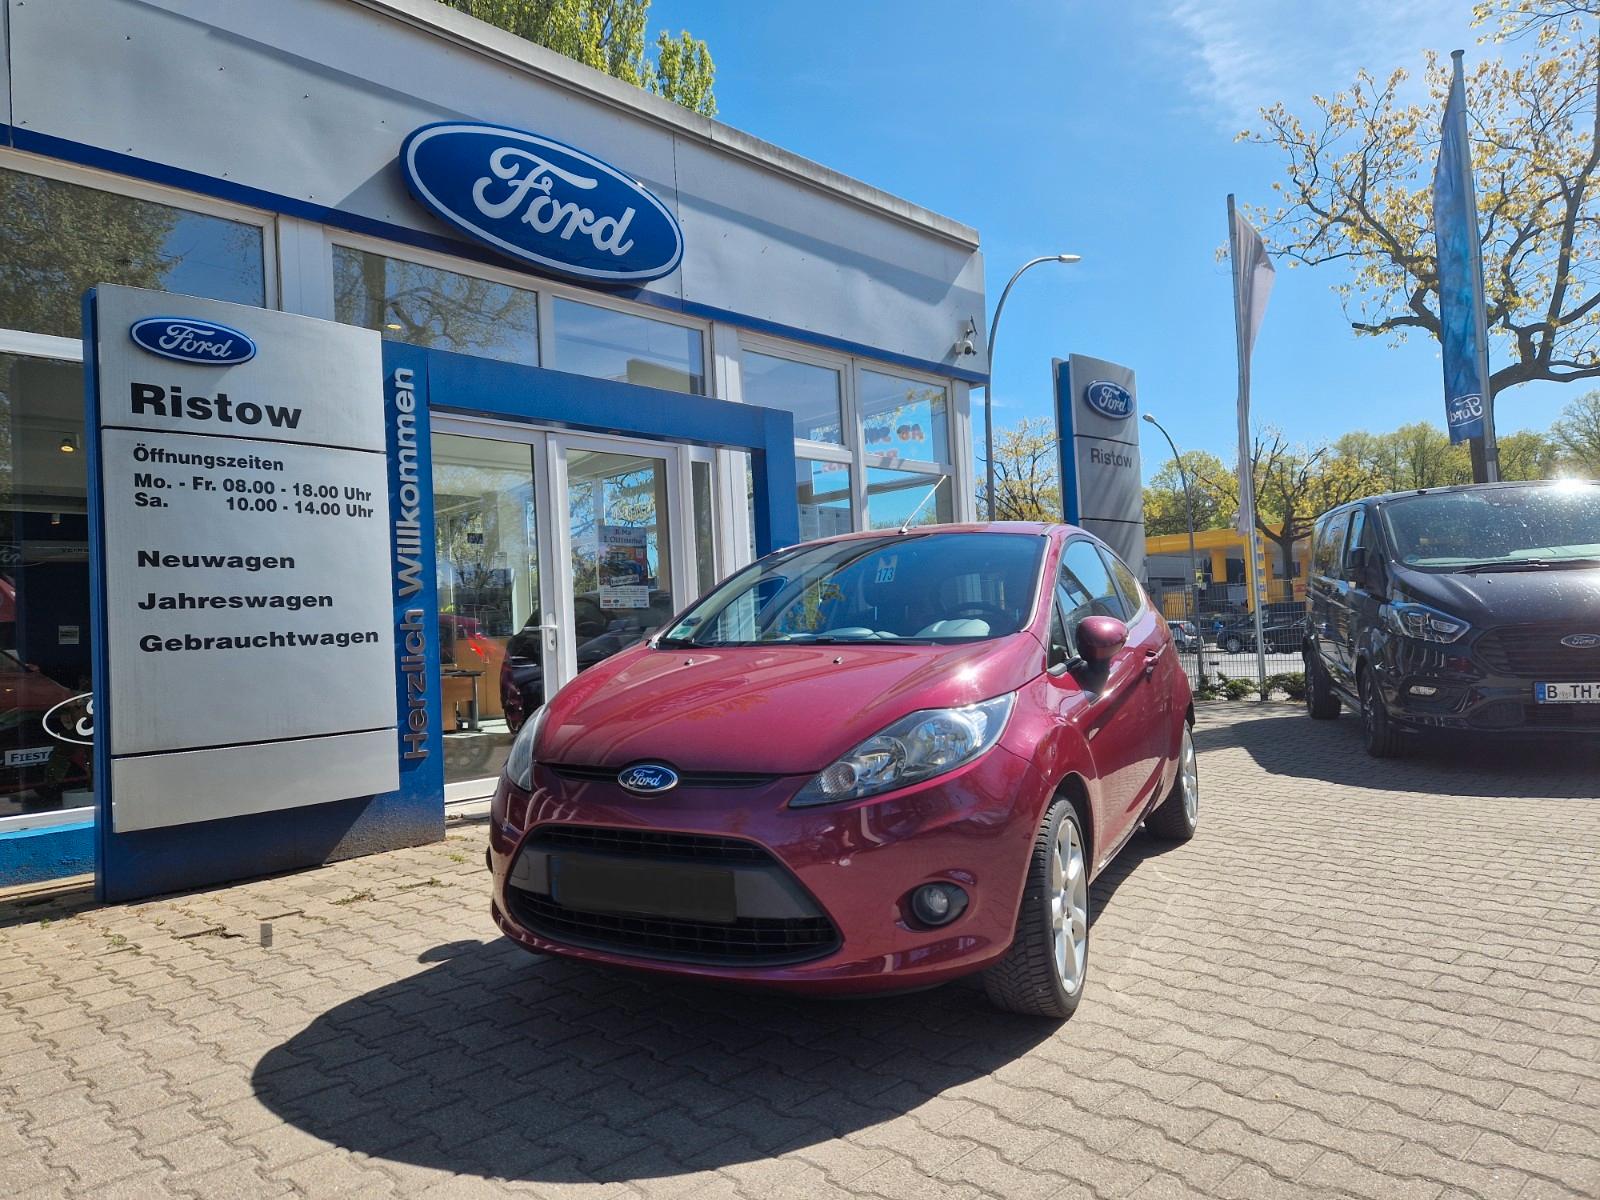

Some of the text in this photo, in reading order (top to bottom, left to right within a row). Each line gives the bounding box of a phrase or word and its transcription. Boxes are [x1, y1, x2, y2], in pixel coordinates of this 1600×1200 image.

[472, 146, 637, 256] Ford
[158, 325, 233, 358] Ford
[130, 382, 302, 429] Ristow
[1099, 386, 1127, 412] Ford
[133, 443, 284, 471] Öffnungszeiten
[1091, 448, 1133, 468] Ristow
[134, 473, 172, 489] Mo.
[192, 476, 217, 492] Fr.
[222, 478, 275, 495] 08.00
[292, 483, 339, 500] 18.00
[343, 486, 372, 502] Uhr
[134, 492, 169, 508] Sa.
[226, 497, 278, 513] 10.00
[294, 501, 341, 516] 14.00
[345, 503, 374, 518] Uhr
[137, 550, 295, 572] Neuwagen
[395, 367, 429, 760] Herzlich Willkommen
[877, 567, 893, 581] 173
[137, 592, 334, 611] Jahreswagen
[139, 631, 379, 653] Gebrauchtwagen
[1547, 685, 1557, 699] B
[1570, 684, 1592, 699] TH
[629, 769, 662, 786] Ford
